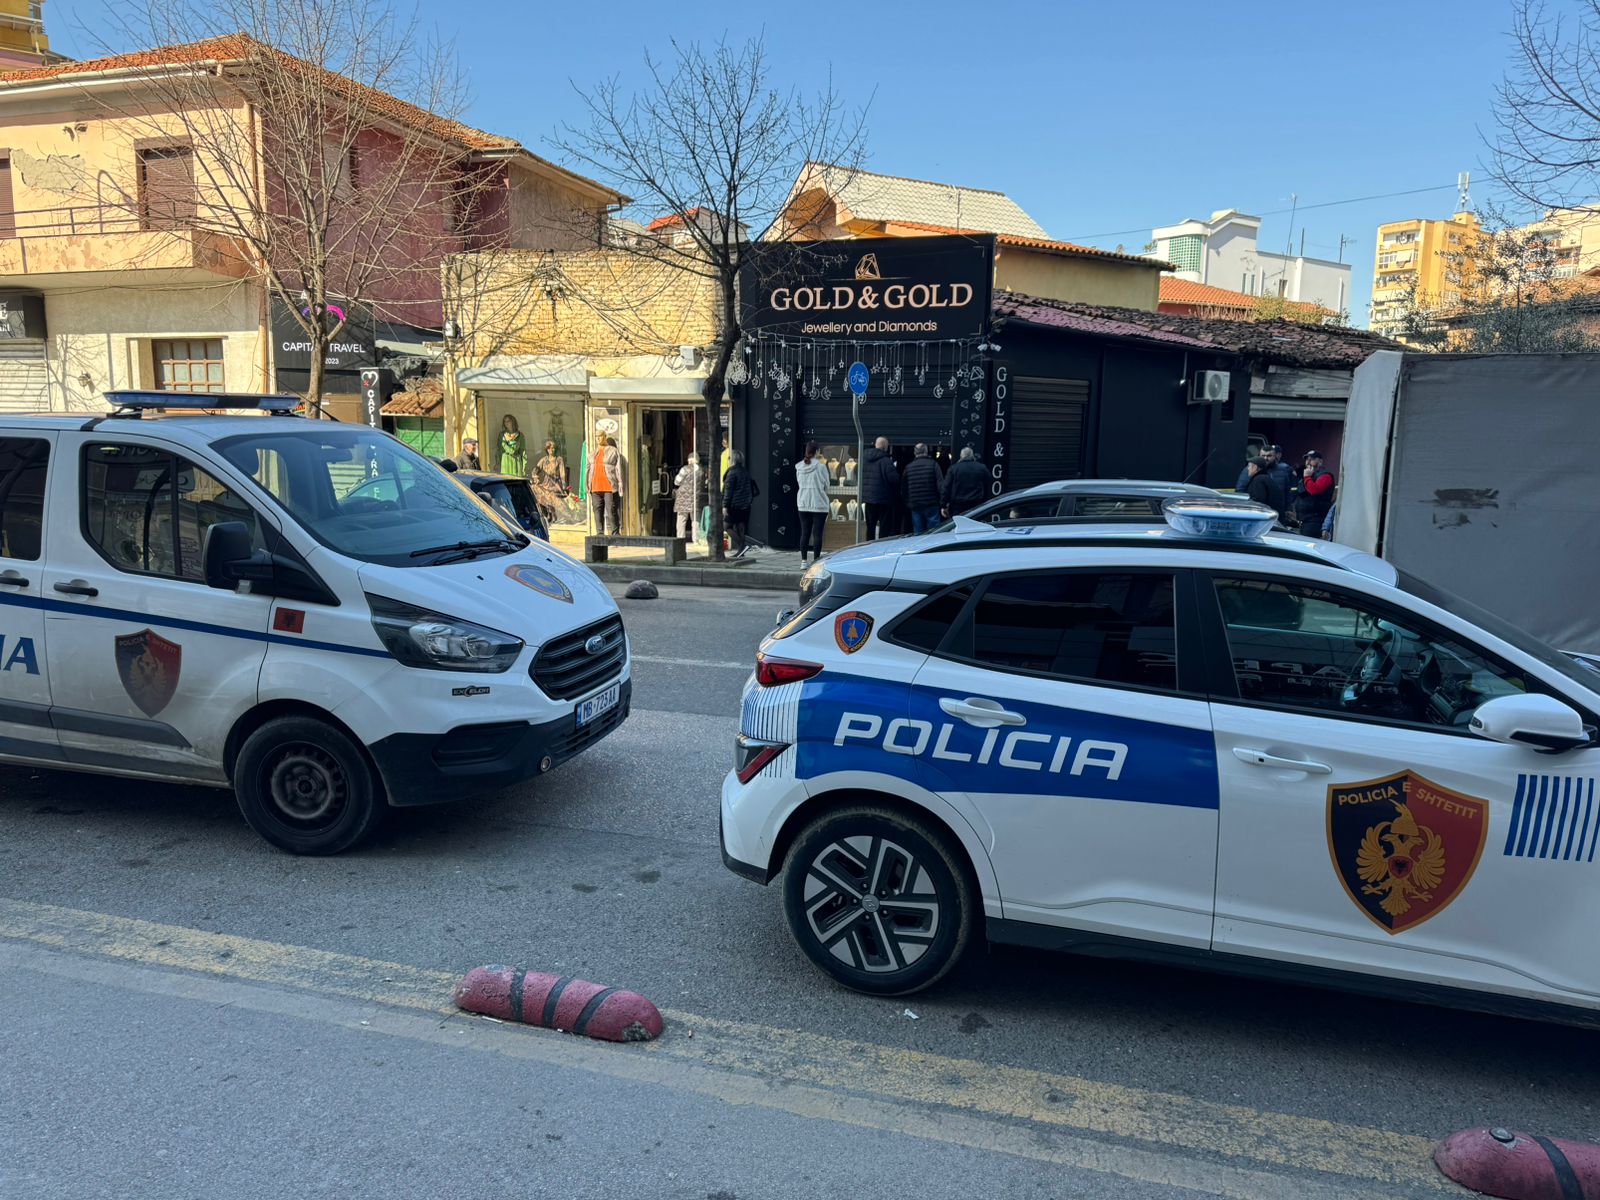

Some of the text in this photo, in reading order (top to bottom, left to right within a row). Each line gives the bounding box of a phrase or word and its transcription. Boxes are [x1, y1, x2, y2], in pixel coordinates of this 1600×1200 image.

[770, 283, 973, 311] GOLD & GOLD
[801, 319, 937, 336] Jewellery and Diamonds
[994, 366, 1008, 433] GOLD
[993, 442, 1004, 457] &
[833, 711, 1129, 781] POLICIA
[1338, 781, 1478, 819] POLICIA E SHTETIT
